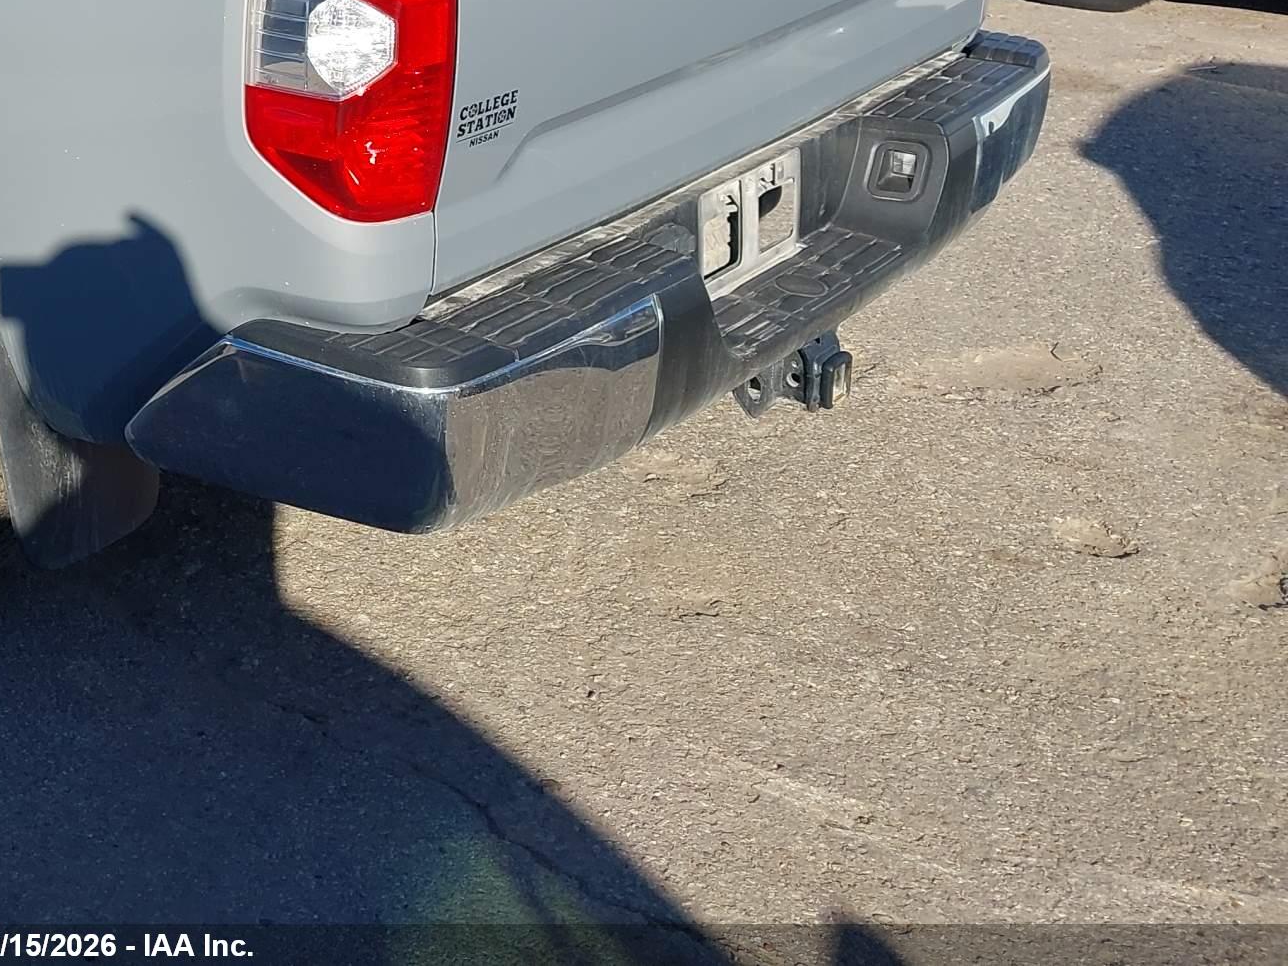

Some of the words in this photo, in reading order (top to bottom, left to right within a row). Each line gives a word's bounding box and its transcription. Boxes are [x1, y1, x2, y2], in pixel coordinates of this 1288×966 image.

[459, 89, 519, 121] COLLEGE
[456, 105, 517, 138] STATION
[469, 130, 500, 148] NISSAN
